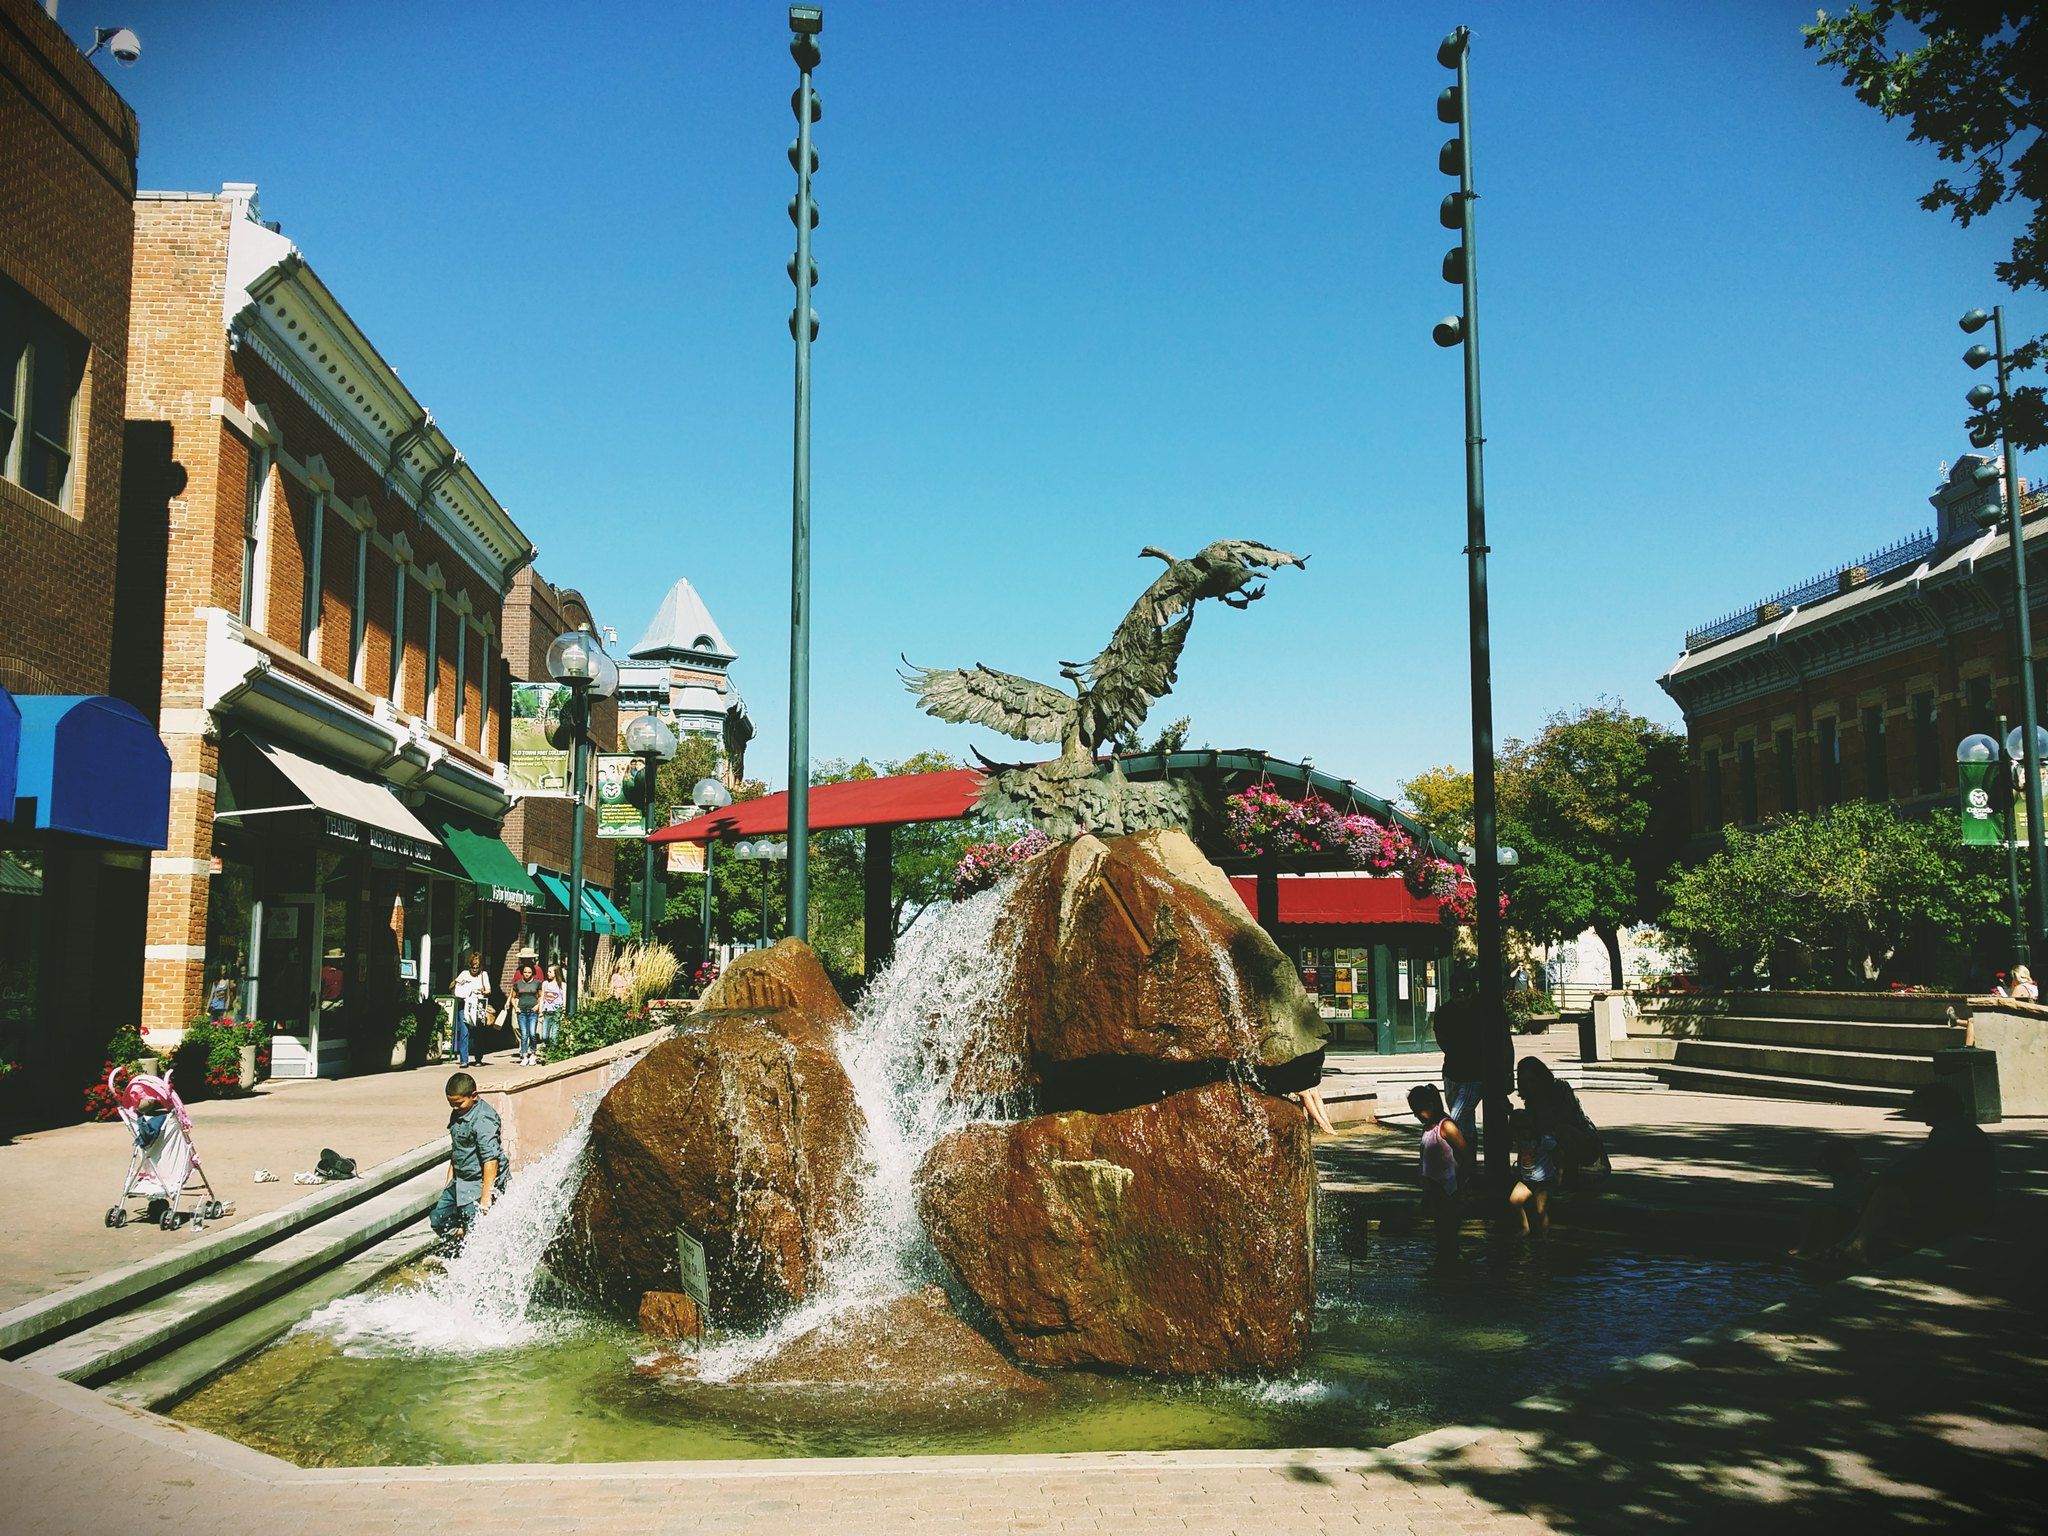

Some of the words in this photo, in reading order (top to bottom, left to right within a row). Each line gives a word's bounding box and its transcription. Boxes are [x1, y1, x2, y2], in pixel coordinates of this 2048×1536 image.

[325, 815, 359, 842] THAMEL
[369, 828, 397, 853] IMPORT
[397, 837, 414, 857] GIFT
[414, 841, 432, 861] SHOP
[492, 884, 504, 901] Visitor
[523, 889, 535, 905] Center
